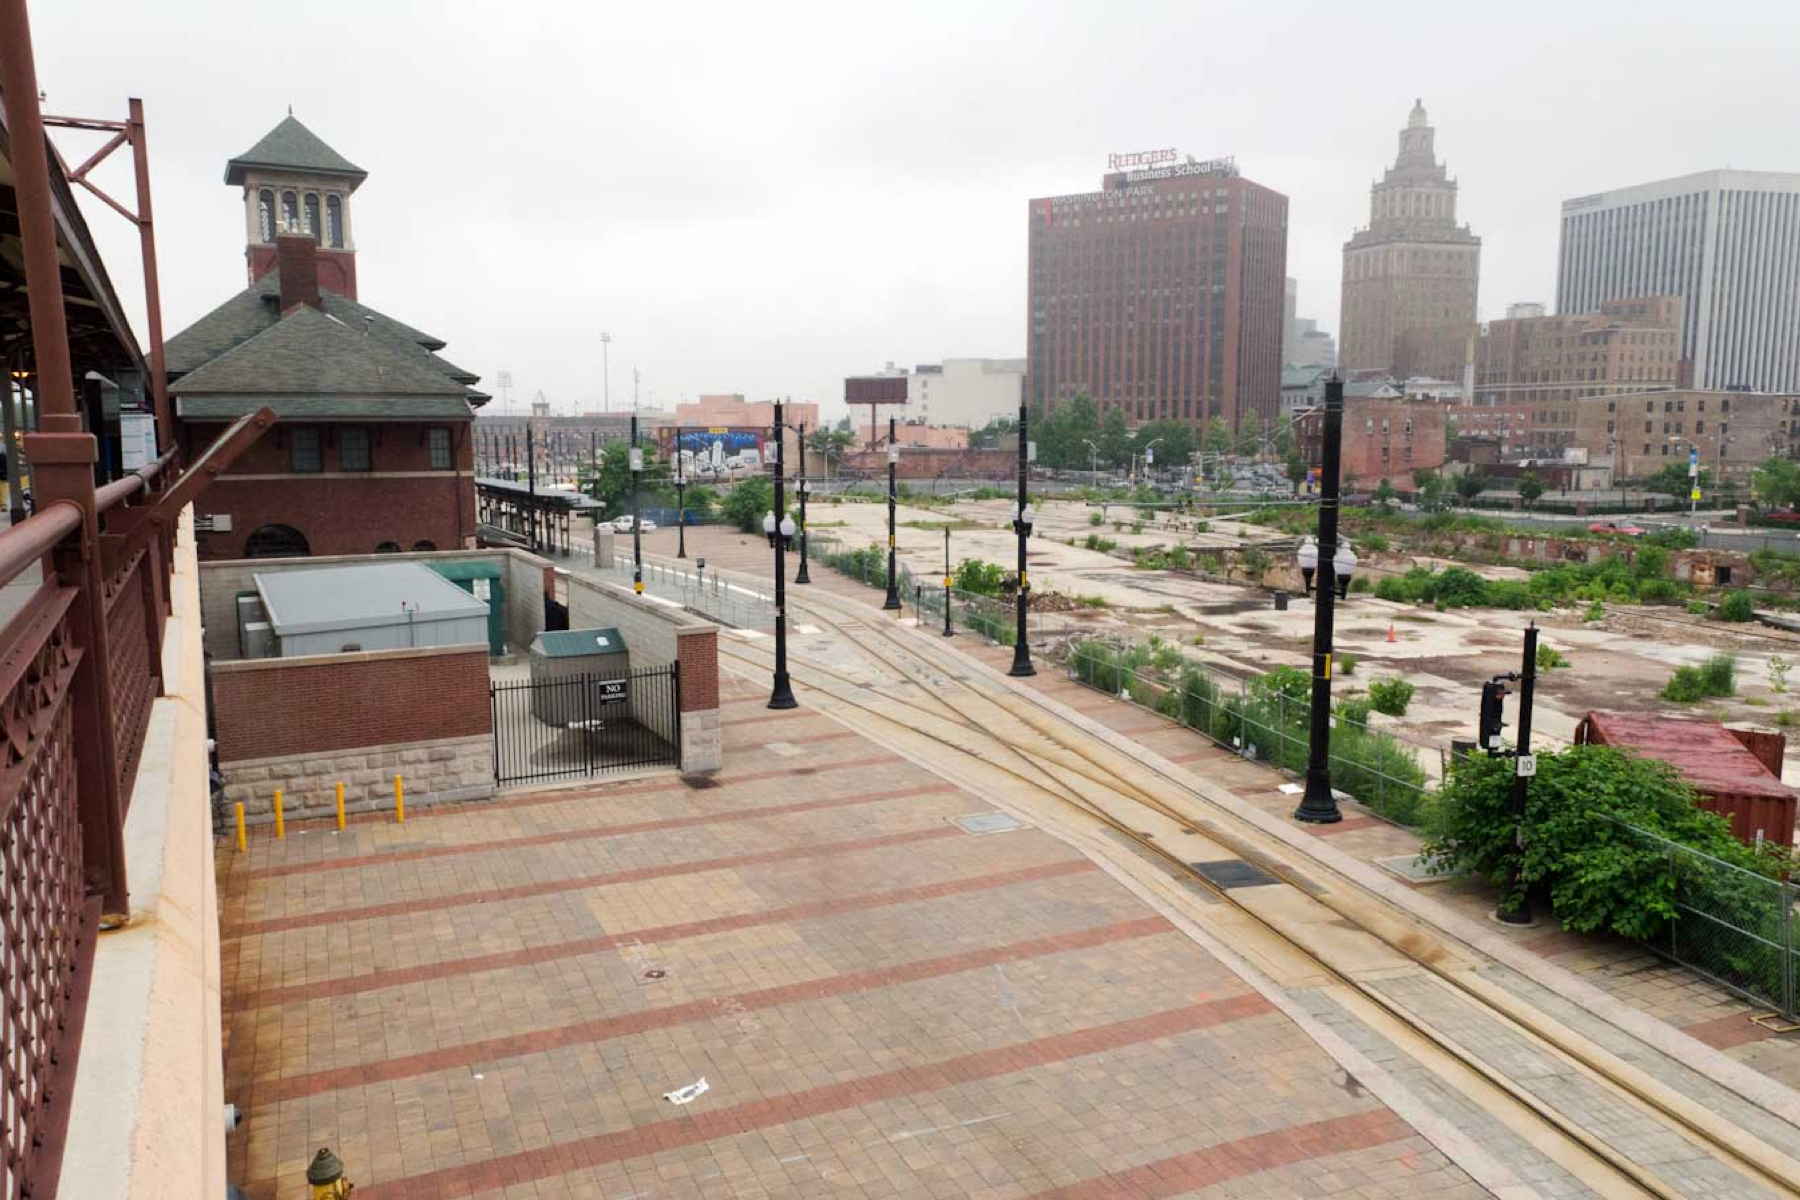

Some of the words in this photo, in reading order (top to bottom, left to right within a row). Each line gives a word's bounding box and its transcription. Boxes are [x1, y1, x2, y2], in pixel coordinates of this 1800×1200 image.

[1108, 148, 1177, 170] RUTGERS
[1127, 166, 1171, 182] Business
[1175, 160, 1211, 176] School
[606, 684, 621, 693] NO
